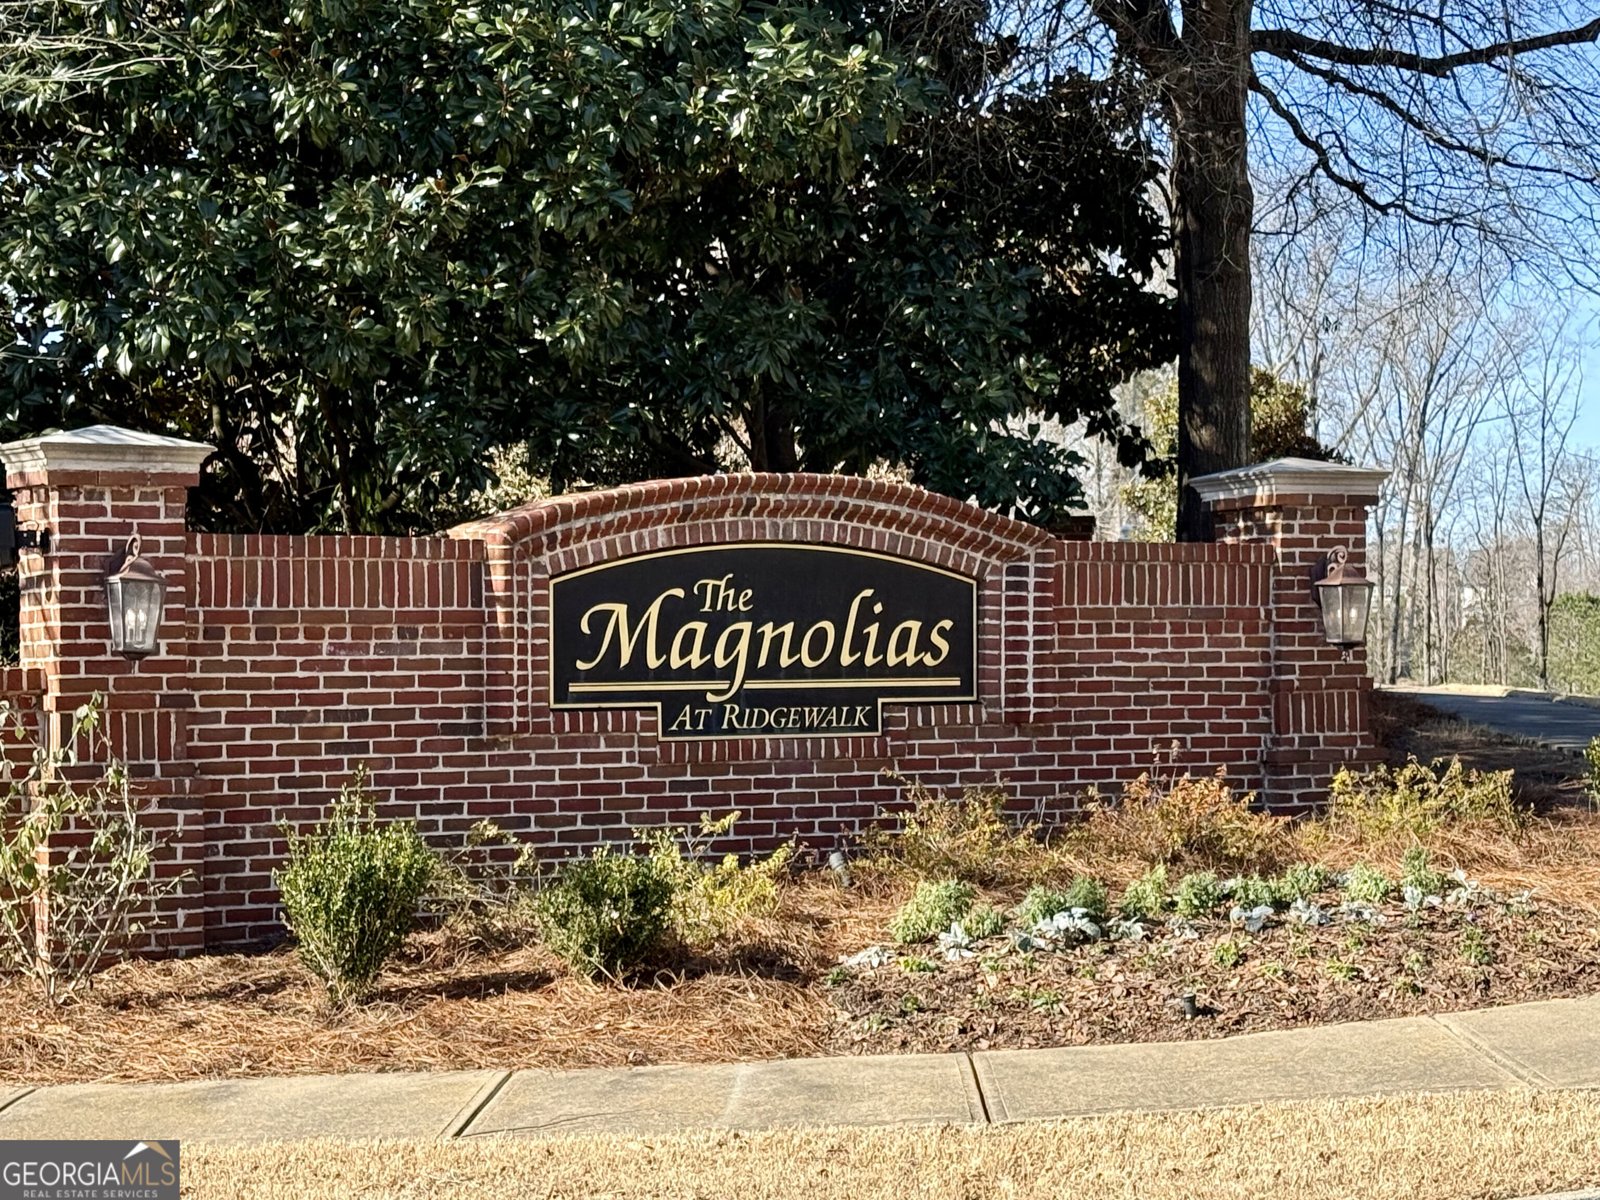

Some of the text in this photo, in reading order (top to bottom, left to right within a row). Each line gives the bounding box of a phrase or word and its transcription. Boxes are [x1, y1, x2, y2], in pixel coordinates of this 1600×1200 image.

[693, 573, 754, 613] The
[576, 587, 955, 702] Magnolias
[668, 703, 873, 731] AT RIDGEWALK
